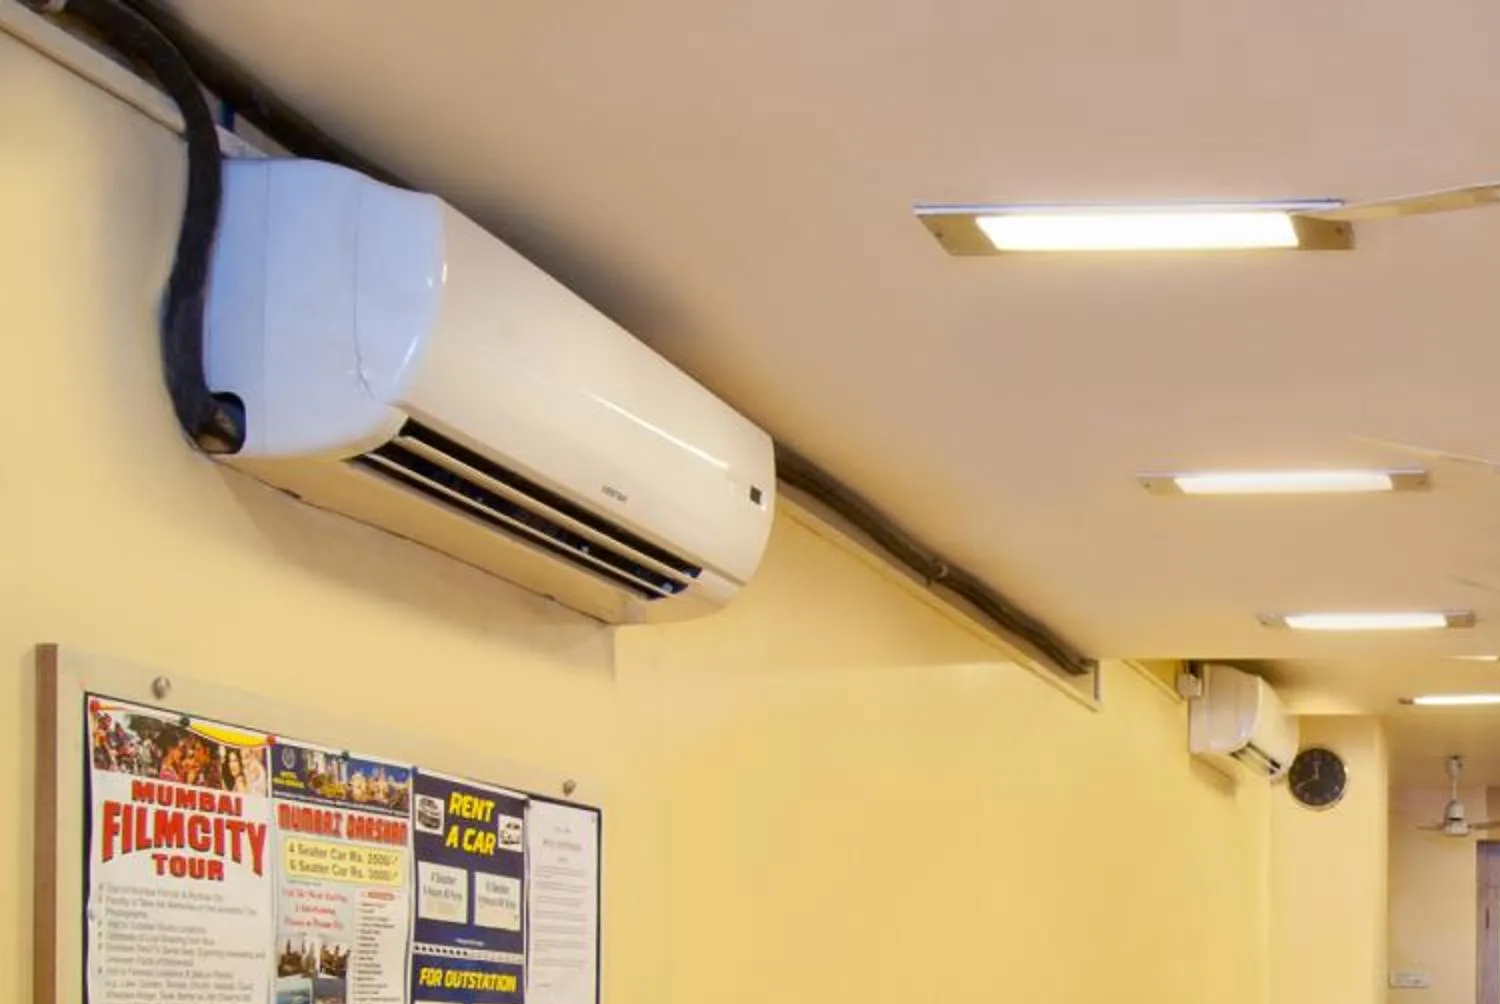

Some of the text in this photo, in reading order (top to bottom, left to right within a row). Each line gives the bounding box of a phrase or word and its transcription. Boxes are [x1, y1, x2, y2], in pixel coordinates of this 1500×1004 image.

[131, 779, 243, 817] MUMBAI
[448, 791, 496, 823] RENT
[101, 799, 267, 877] FILMCITY
[297, 843, 328, 858] Seater
[329, 848, 346, 860] Car
[445, 824, 497, 856] A CAR
[151, 852, 225, 882] TOUR
[299, 860, 329, 874] Seater
[331, 863, 348, 877] Car
[419, 967, 517, 992] FOR OUTSTATION
